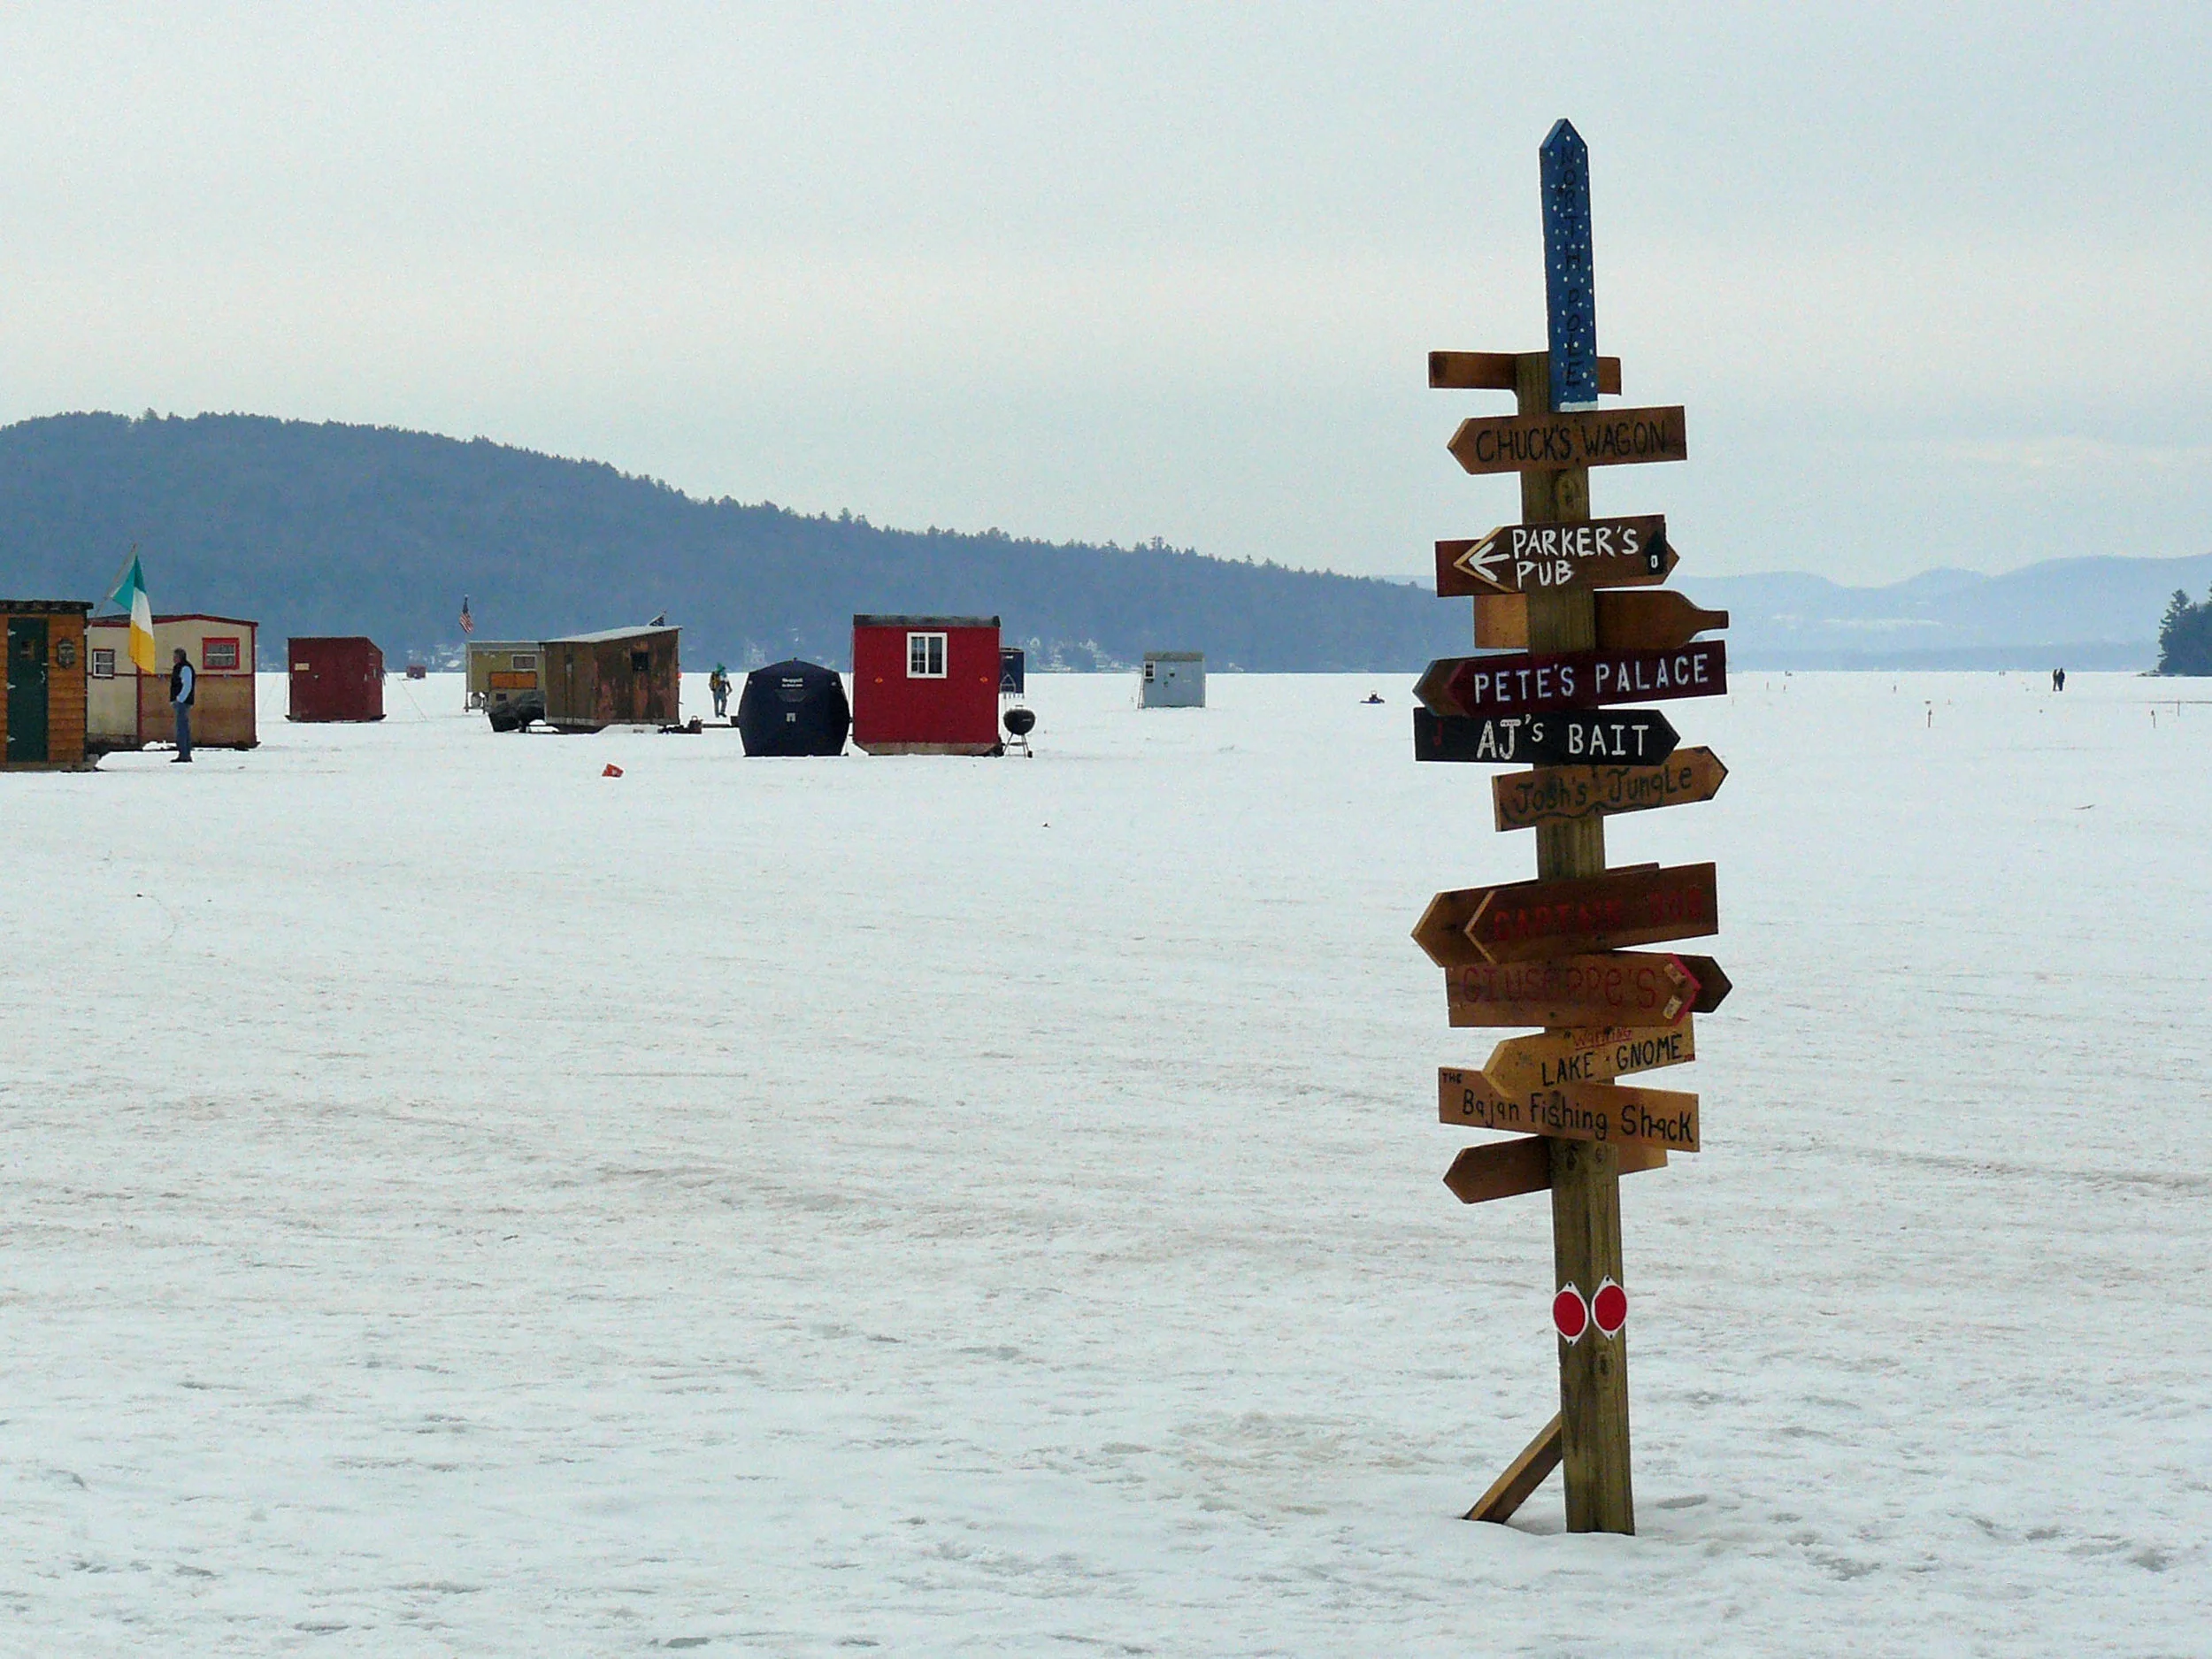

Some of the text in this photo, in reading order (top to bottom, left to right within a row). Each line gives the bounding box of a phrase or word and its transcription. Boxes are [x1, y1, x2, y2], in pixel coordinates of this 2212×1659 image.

[1560, 144, 1585, 387] NORTH POLE
[1475, 420, 1666, 463] CHUCK'S WAGON
[1512, 526, 1640, 560] PARKER'S
[1516, 559, 1575, 589] PUB
[1473, 653, 1709, 704] PETE'S PALACE
[1476, 713, 1650, 761] AJ's BAIT
[1441, 1071, 1463, 1084] THE
[1540, 1033, 1683, 1087] LAKE GNOME
[1462, 1088, 1520, 1128] Bajan
[1529, 1091, 1608, 1141] Fishing
